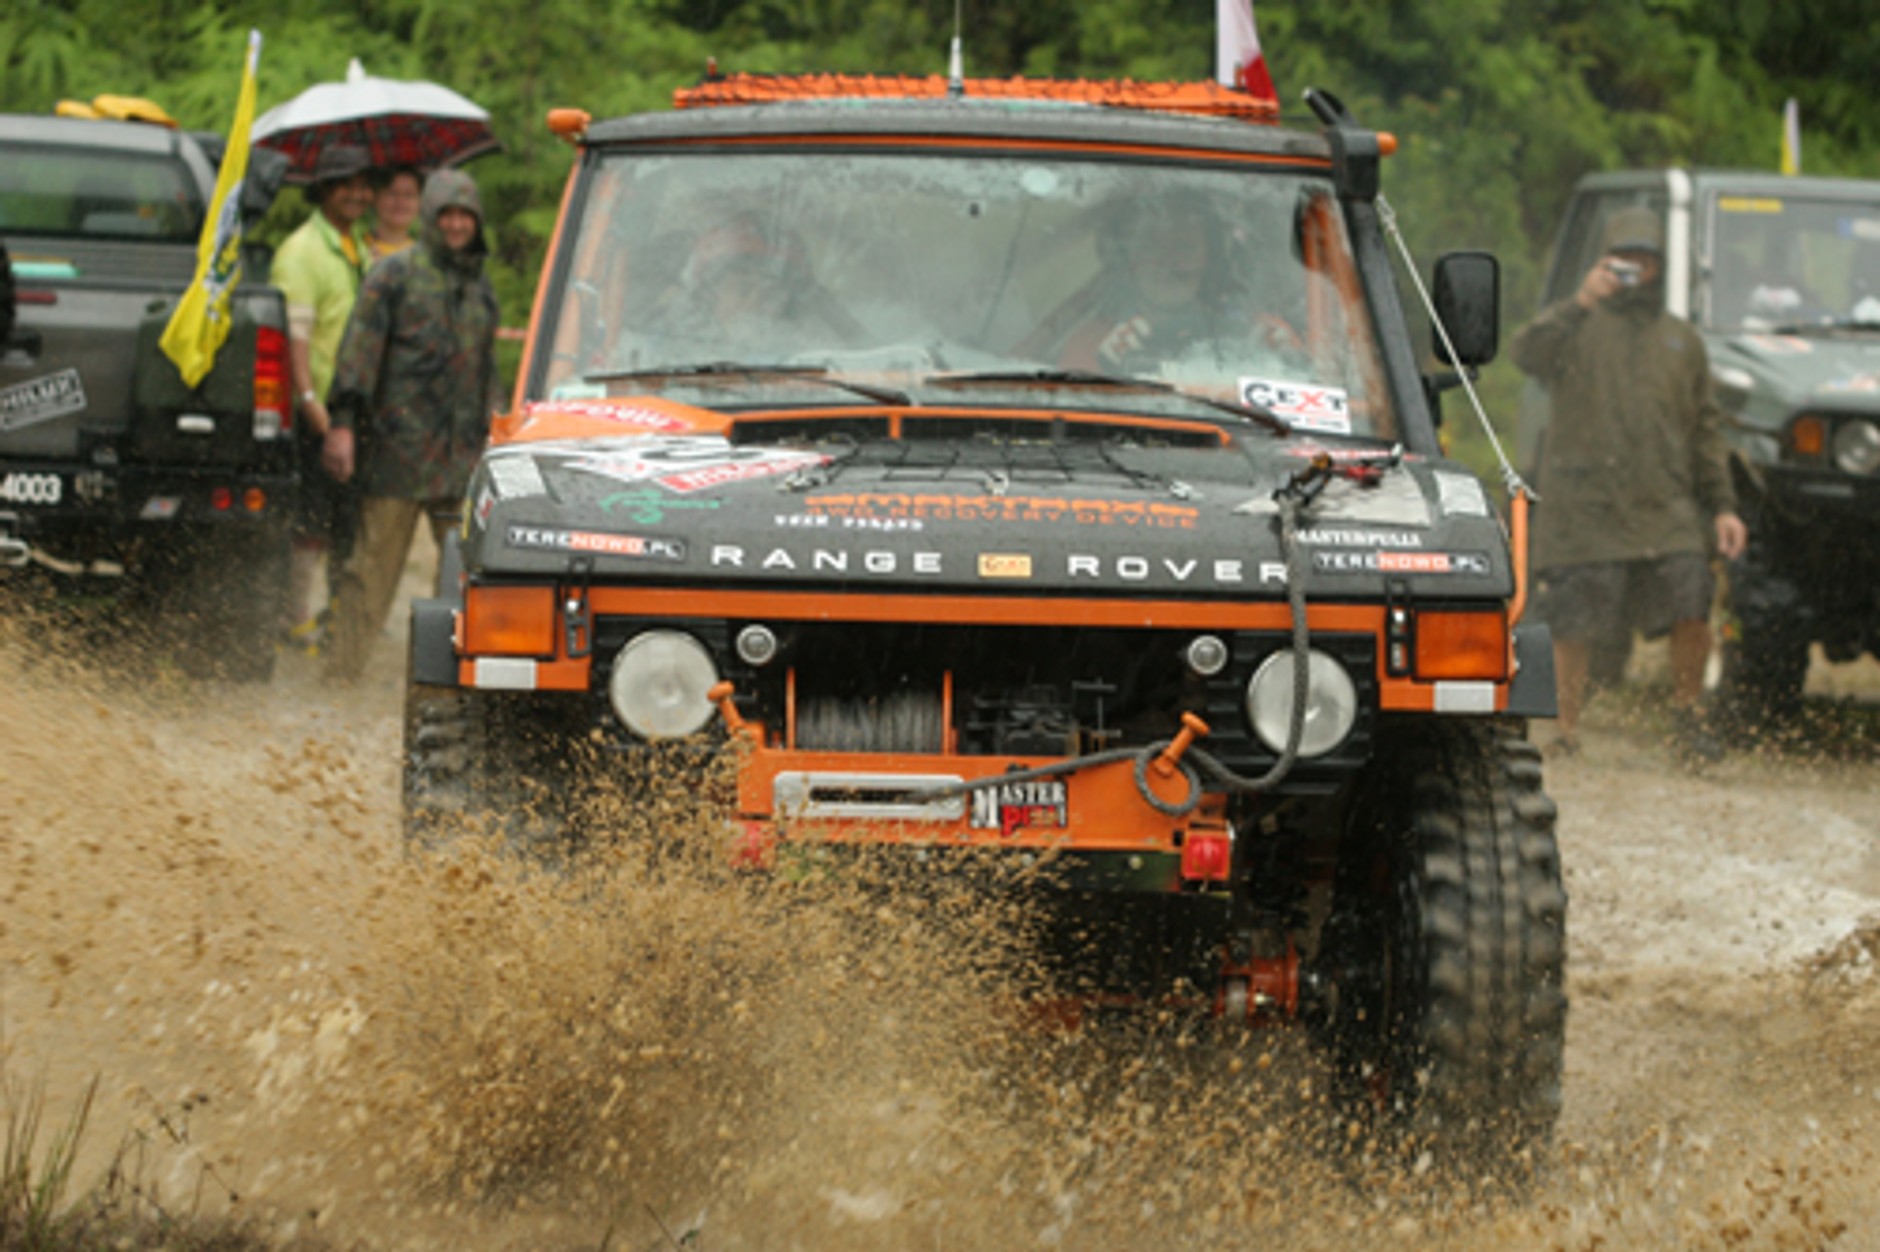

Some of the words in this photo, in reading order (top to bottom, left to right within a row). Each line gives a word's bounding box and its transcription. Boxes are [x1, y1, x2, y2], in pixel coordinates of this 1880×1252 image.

[889, 506, 1063, 522] RECOVERY
[1076, 511, 1198, 528] DEVICE
[712, 545, 943, 574] RANGE
[1067, 554, 1289, 584] ROVER
